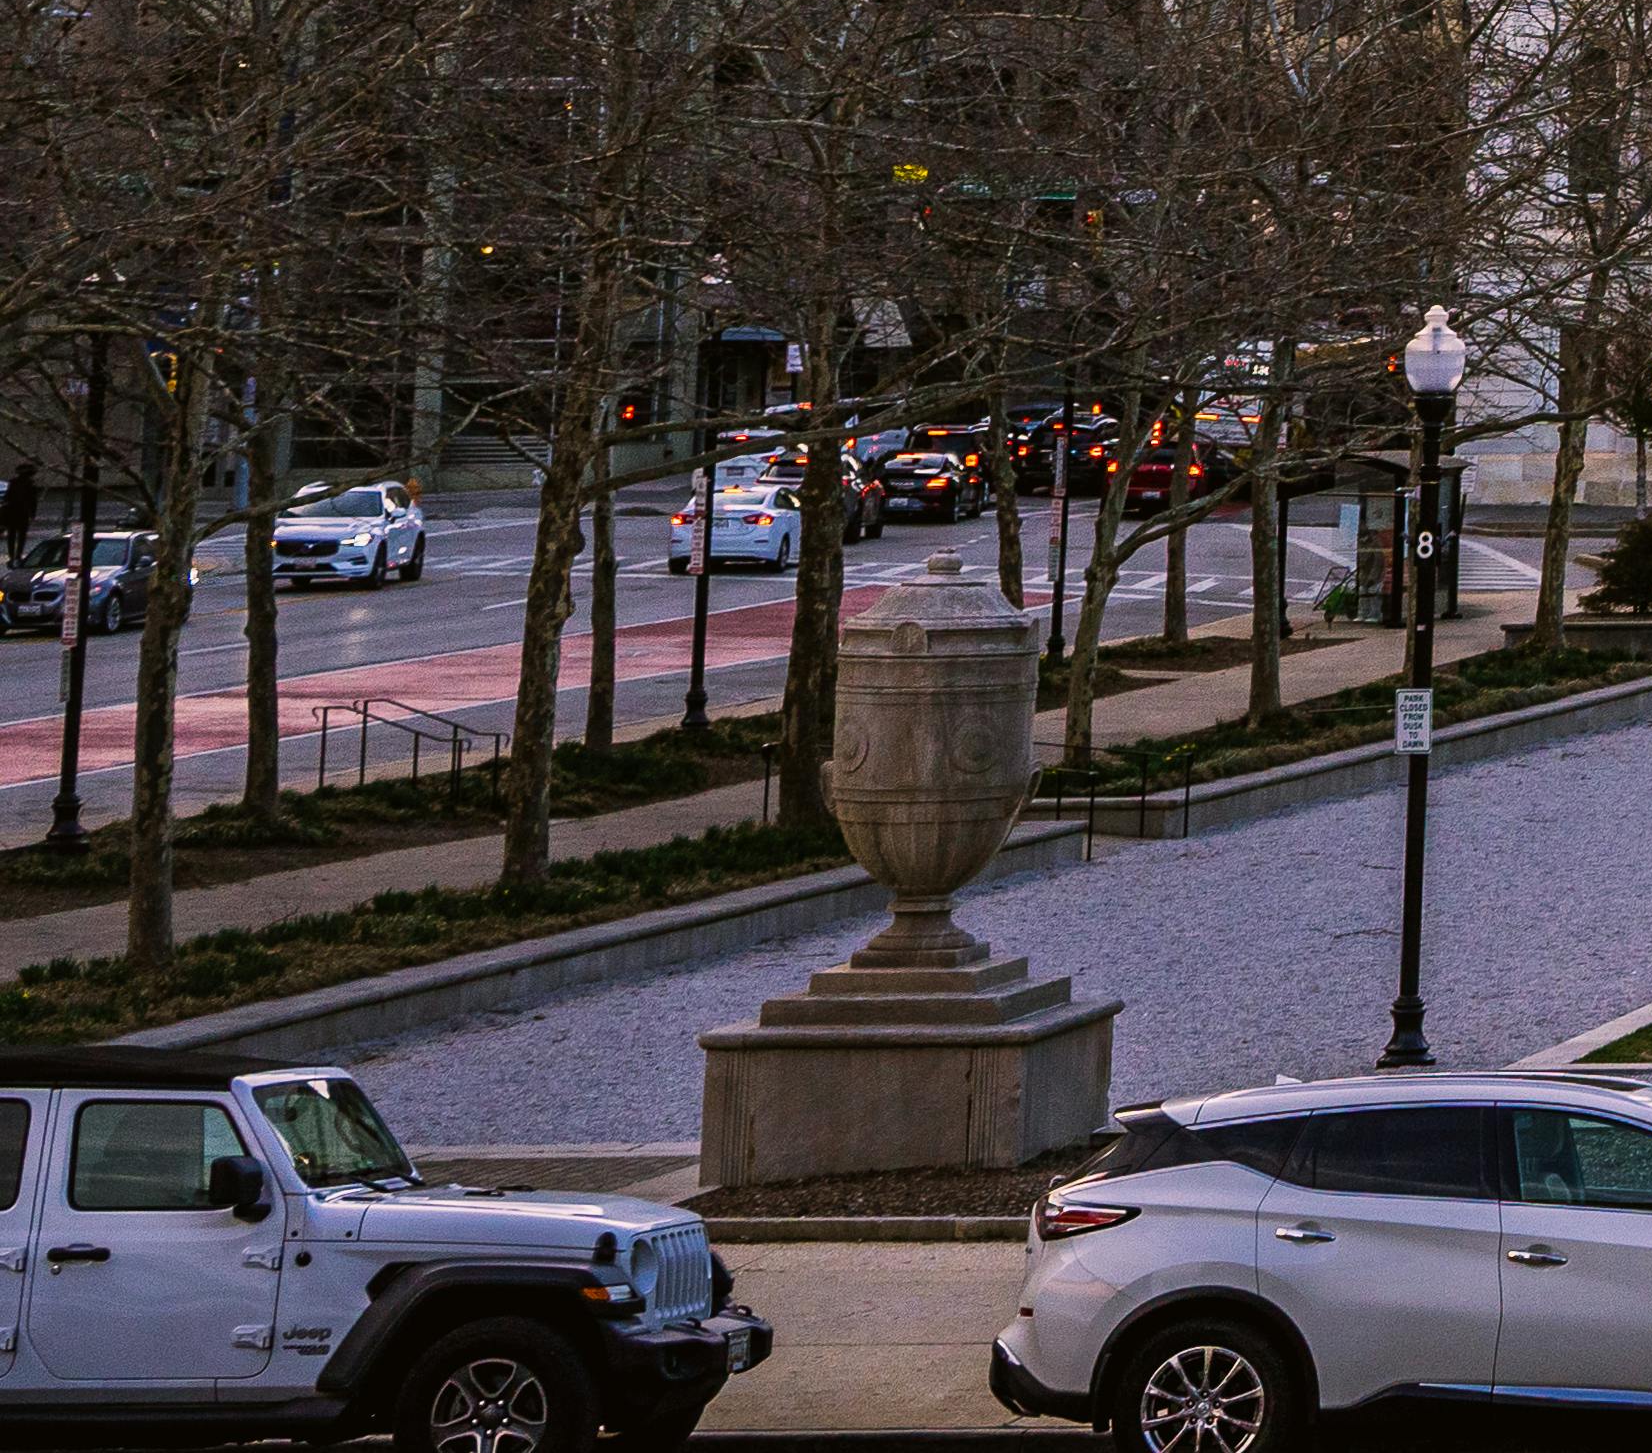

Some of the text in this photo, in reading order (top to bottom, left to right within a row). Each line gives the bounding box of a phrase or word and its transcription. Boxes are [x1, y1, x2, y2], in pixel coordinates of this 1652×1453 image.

[1416, 531, 1434, 559] 8
[1399, 704, 1429, 712] CLOSED
[1402, 713, 1424, 721] FROM
[1402, 722, 1424, 730] DUSK
[1408, 731, 1418, 739] TO
[1402, 740, 1425, 748] DAWN
[282, 1324, 332, 1343] Jeep
